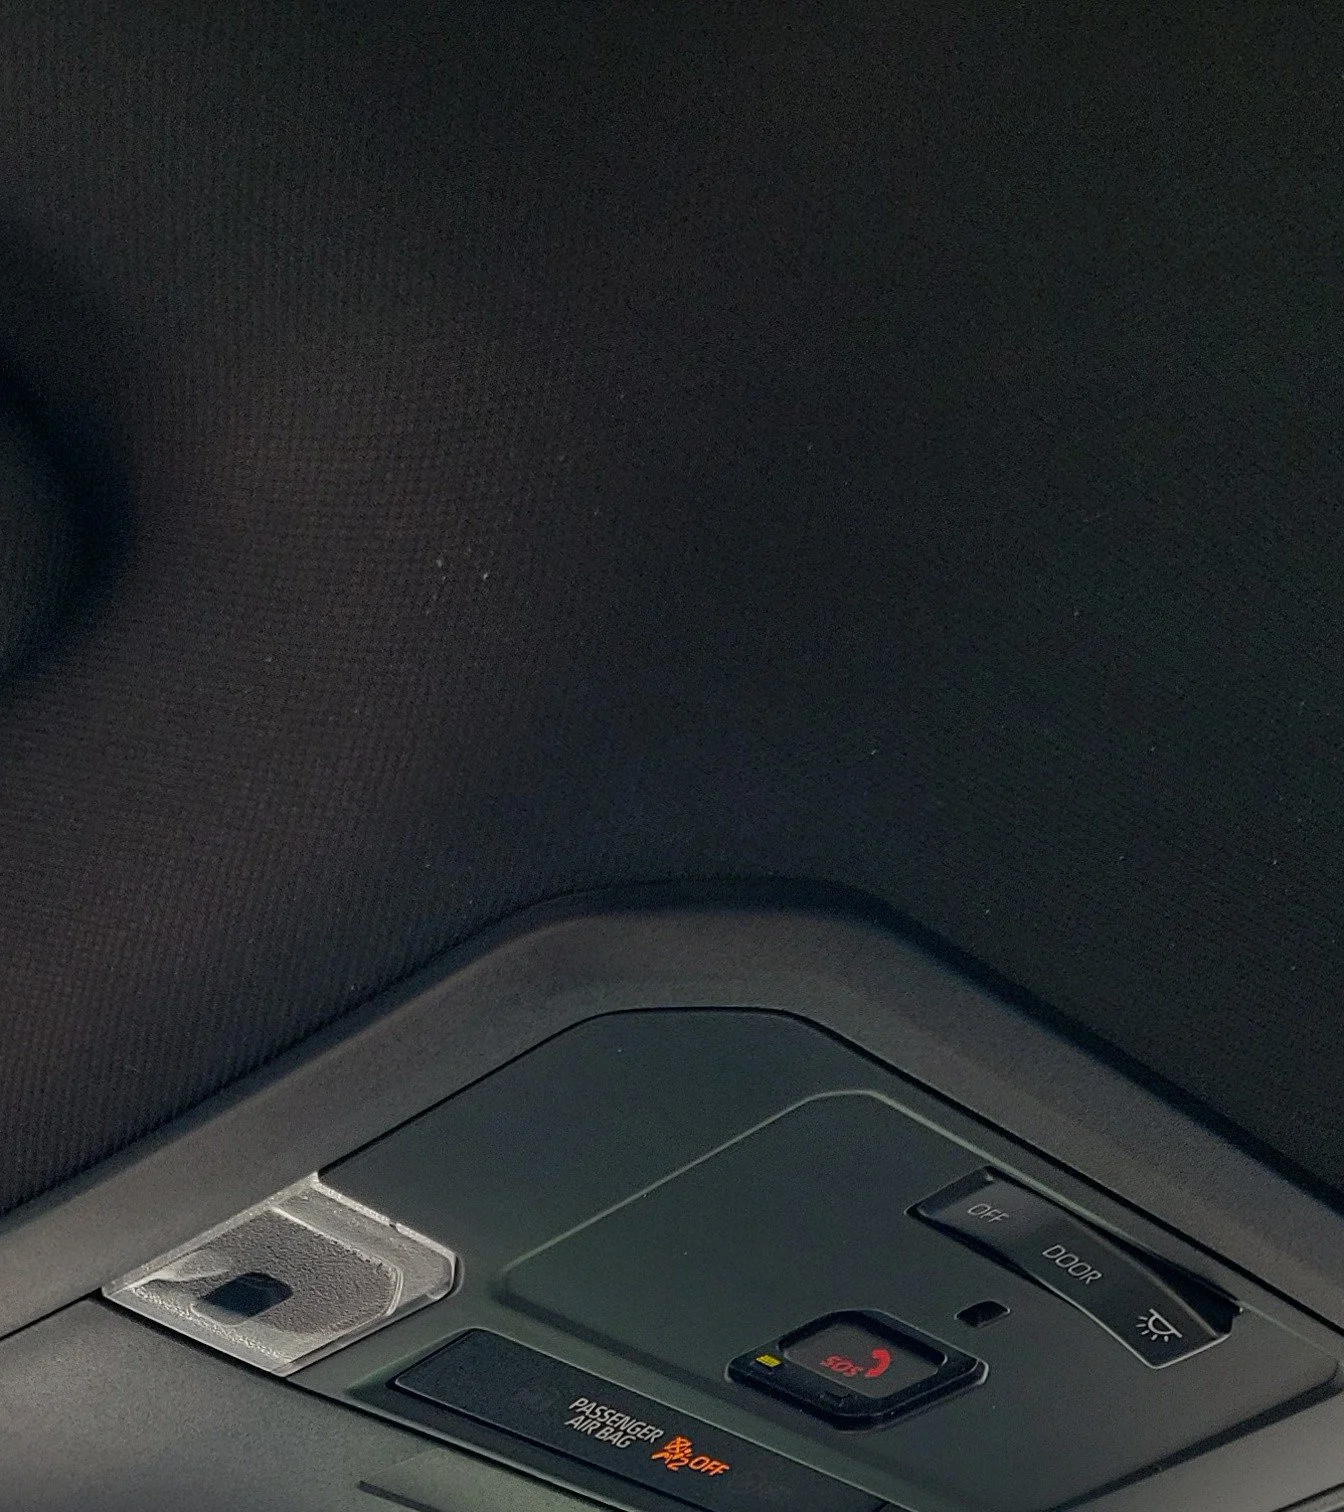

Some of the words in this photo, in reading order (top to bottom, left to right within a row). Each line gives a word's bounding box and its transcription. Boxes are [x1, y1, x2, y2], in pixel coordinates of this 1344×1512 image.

[967, 1201, 1010, 1226] OFF
[1041, 1243, 1102, 1286] DOOR
[819, 1355, 864, 1377] SOS
[564, 1415, 596, 1436] AIR
[595, 1425, 637, 1450] BAG
[568, 1397, 664, 1443] PASSENGER
[688, 1454, 732, 1477] OFF
